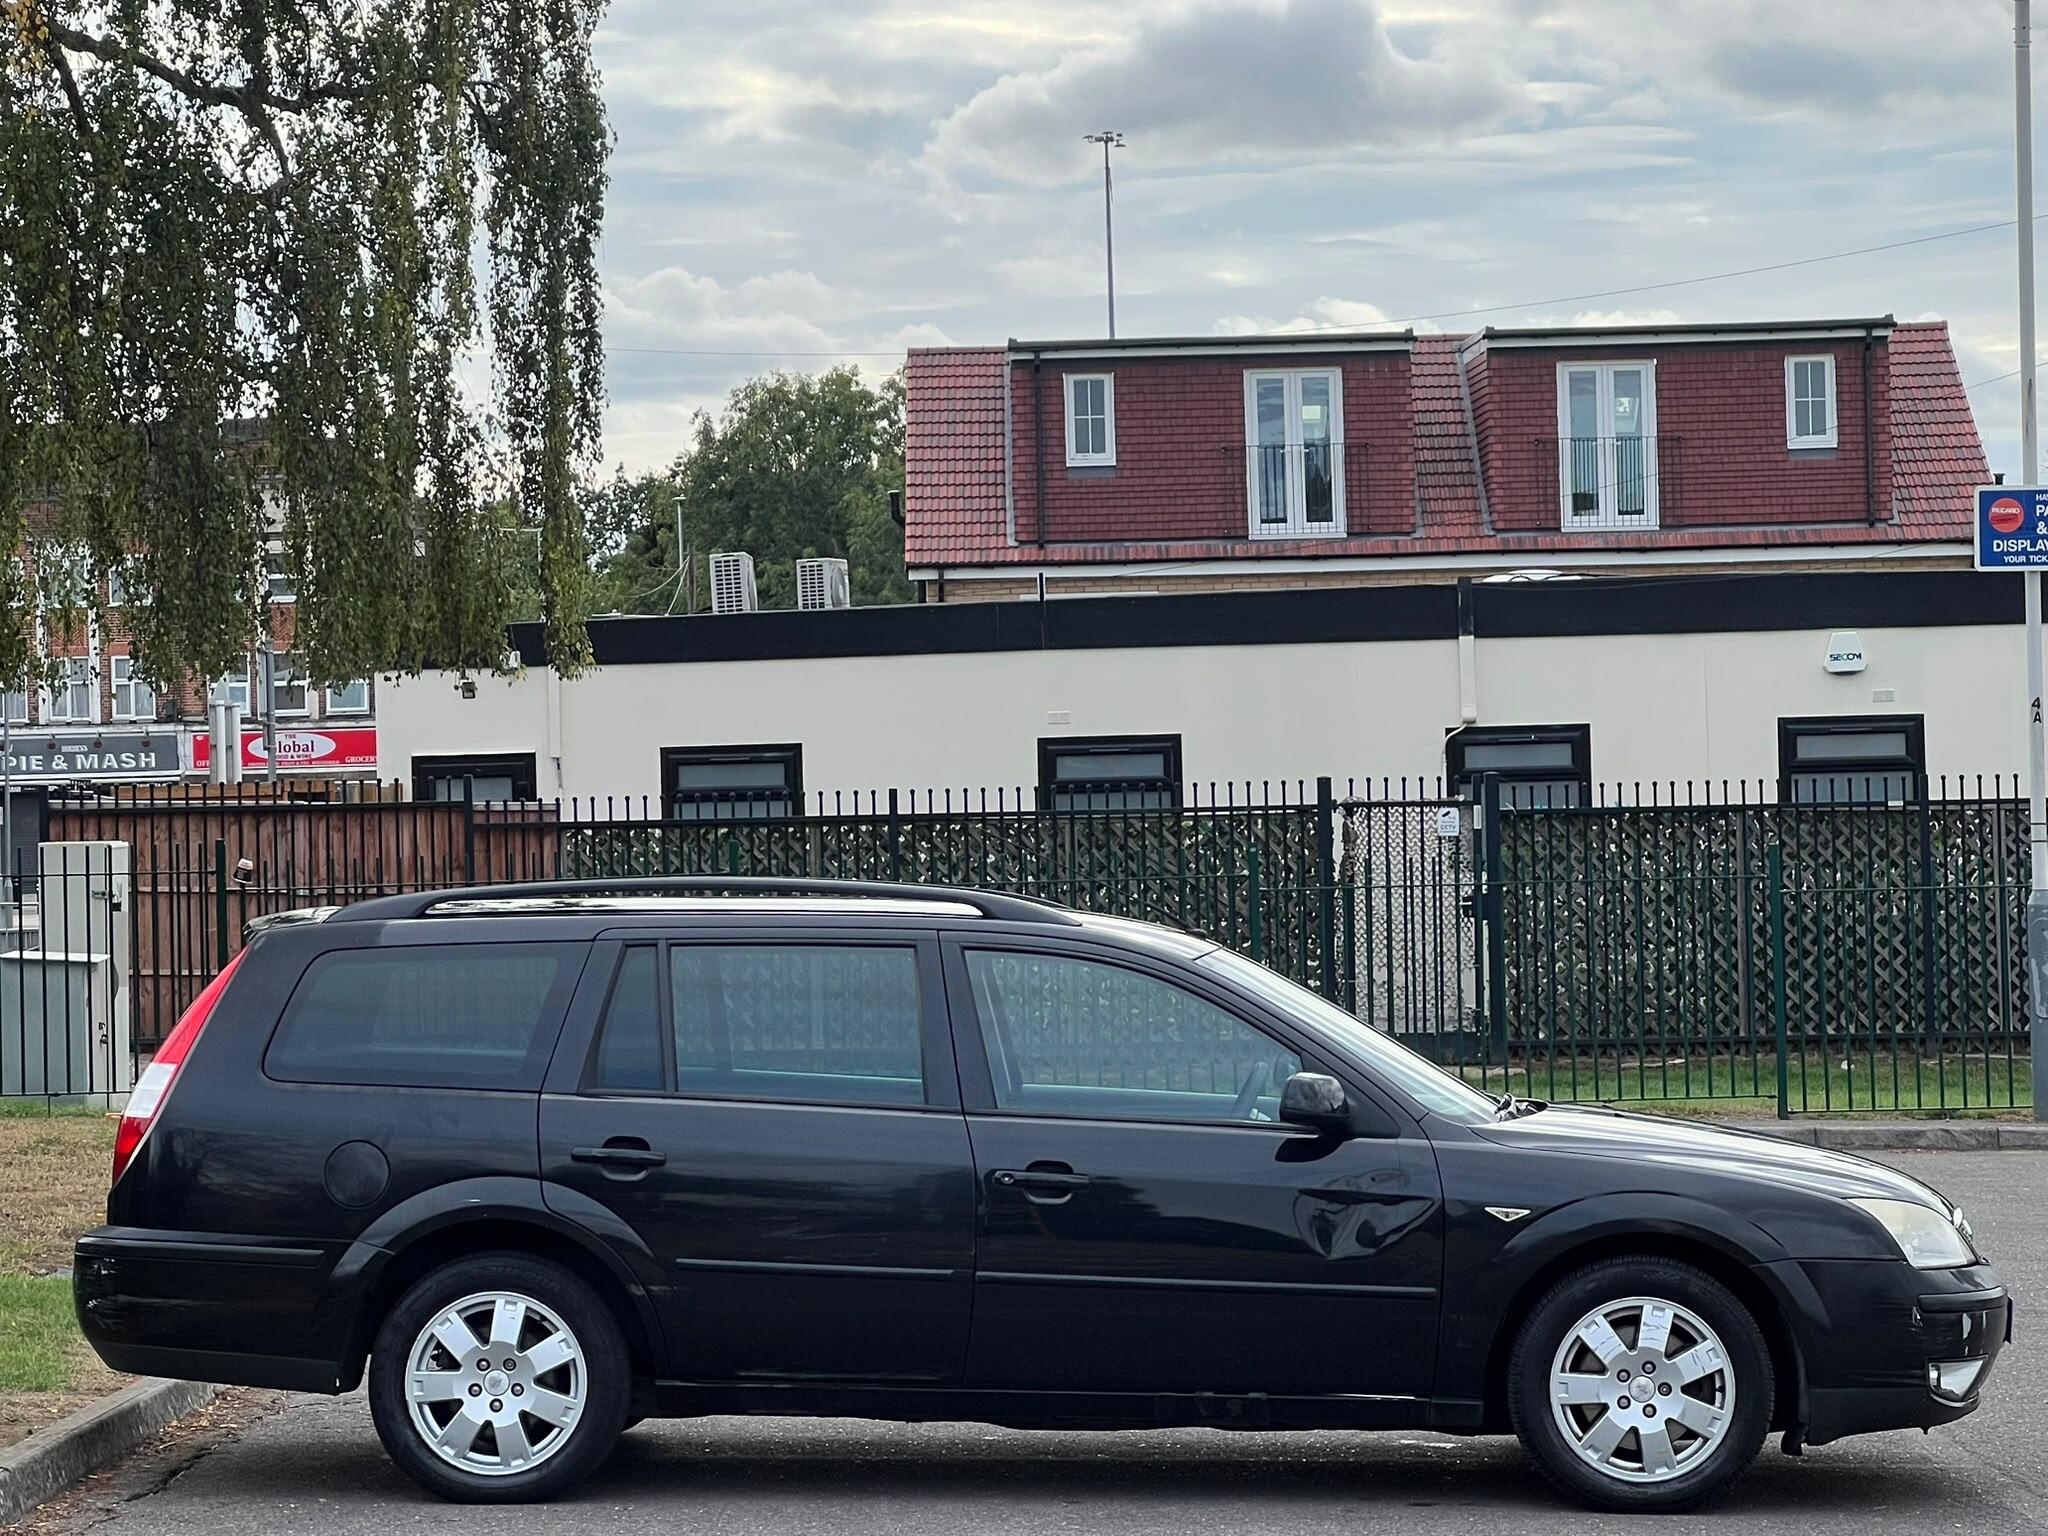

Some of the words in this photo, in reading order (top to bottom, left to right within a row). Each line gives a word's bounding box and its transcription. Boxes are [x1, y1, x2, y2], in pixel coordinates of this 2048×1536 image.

[2003, 555, 2026, 563] YOUR
[1829, 653, 1862, 661] SECOM
[2032, 697, 2041, 709] 4
[2033, 711, 2042, 723] A
[276, 740, 315, 753] lobal
[1, 756, 43, 771] PIE
[52, 754, 69, 770] &
[75, 752, 156, 769] MASH
[344, 756, 377, 764] GROCER
